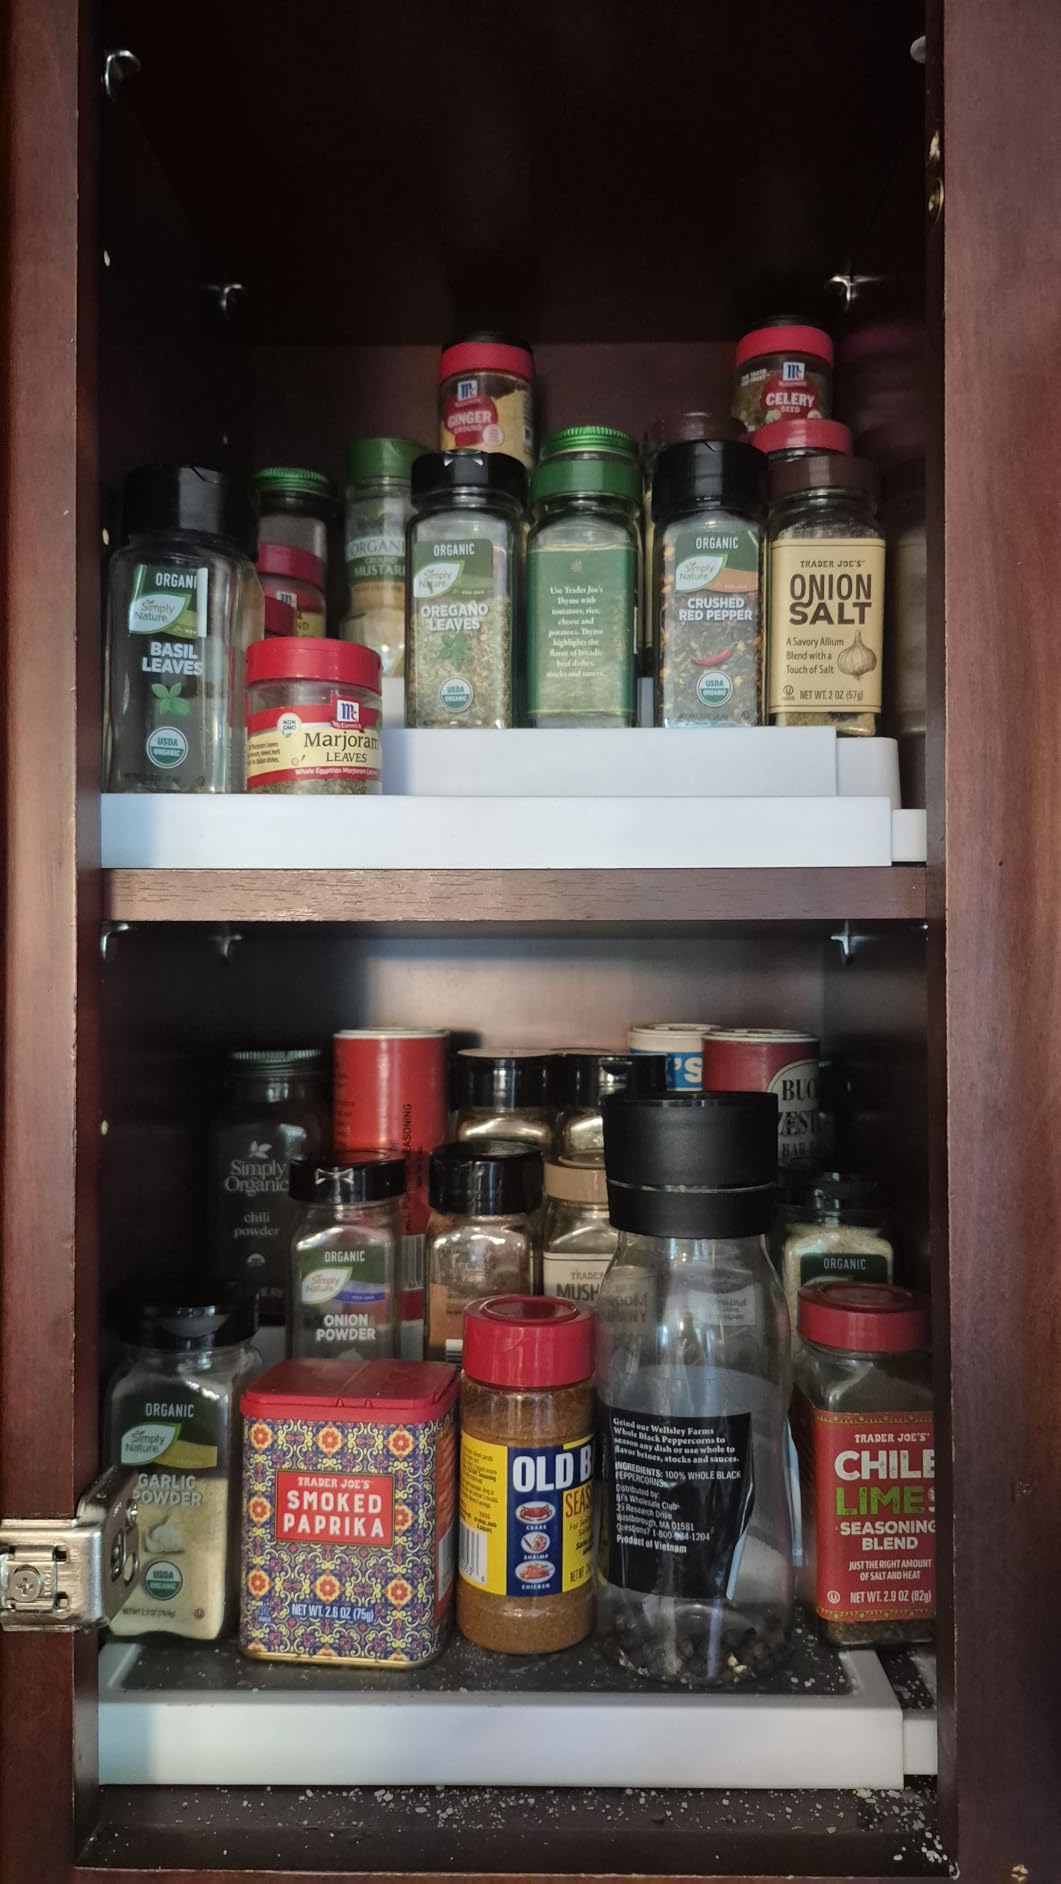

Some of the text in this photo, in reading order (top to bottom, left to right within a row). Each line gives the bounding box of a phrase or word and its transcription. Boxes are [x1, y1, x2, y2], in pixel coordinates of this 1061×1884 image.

[765, 392, 815, 408] CELERY
[447, 410, 492, 428] GINGER
[434, 544, 475, 556] ORGANIC
[696, 536, 738, 550] ORGANIC
[685, 563, 714, 576] Simply
[800, 560, 863, 568] TRADER JOE'S
[680, 571, 708, 581] Nature
[789, 574, 872, 609] ONION
[141, 601, 175, 614] Simply
[421, 603, 489, 618] OREGANO
[688, 598, 745, 609] CRUSHED
[135, 612, 168, 622] Nature
[679, 610, 752, 621] RED PEPPER
[789, 602, 872, 626] SALT
[430, 618, 480, 632] LEAVES
[150, 642, 198, 659] BASIL
[786, 638, 844, 649] A Savory Allium
[786, 652, 808, 660] Blend
[809, 651, 824, 660] with
[142, 656, 204, 676] LEAVES
[786, 665, 834, 674] Touch of Salt
[447, 686, 464, 694] USDA
[706, 680, 724, 688] USDA
[800, 690, 812, 700] NET
[828, 690, 832, 700] 2
[834, 690, 844, 700] OZ
[846, 690, 864, 702] (57g)
[158, 736, 178, 746] USDA
[304, 731, 380, 752] Marjoram
[154, 748, 181, 757] ORGANIC
[326, 752, 368, 763] LEAVES
[296, 768, 314, 776] Whole
[230, 1160, 288, 1180] Simply
[225, 1175, 289, 1197] Organic
[244, 1211, 270, 1223] chili
[233, 1226, 280, 1239] powder
[324, 1250, 366, 1263] ORGANIC
[824, 1258, 866, 1270] ORGANIC
[324, 1314, 369, 1327] ONION
[316, 1328, 376, 1342] POWDER
[146, 1403, 194, 1417] ORGANIC
[613, 1417, 714, 1436] Grind our Wellsley Farms
[131, 1432, 166, 1446] Simply
[614, 1426, 638, 1438] Whole
[638, 1432, 660, 1442] Black
[662, 1436, 715, 1446] Peppercorns
[854, 1432, 926, 1444] TRADER JOE'S
[125, 1443, 160, 1454] Nature
[614, 1437, 638, 1448] season
[640, 1443, 653, 1452] any
[654, 1444, 672, 1454] dish
[700, 1446, 725, 1454] whole
[726, 1446, 736, 1454] to
[615, 1445, 740, 1464] flavor brines, stocks and sauces.
[615, 1461, 742, 1480] INGREDIENTS: 100% WHOLE BLACK
[834, 1449, 936, 1480] CHILE
[512, 1452, 574, 1493] OLD
[138, 1473, 196, 1489] GARLIC
[298, 1477, 370, 1489] TRADER JOE'S
[616, 1484, 649, 1497] Distributed
[132, 1490, 204, 1506] POWDER
[287, 1490, 382, 1515] SMOKED
[629, 1495, 660, 1510] Wholesale
[835, 1485, 924, 1517] LIME
[616, 1504, 673, 1521] 25 Research Drive
[283, 1513, 384, 1538] PAPRIKA
[616, 1523, 650, 1537] Questions?
[659, 1520, 670, 1530] MA
[672, 1521, 694, 1532] 01581
[840, 1520, 936, 1536] SEASONING
[616, 1534, 687, 1554] Product of Vietnam
[862, 1536, 919, 1551] BLEND
[849, 1558, 932, 1571] JUST THE RIGHT AMOUNT
[860, 1570, 921, 1581] OF SALT AND HEAT
[850, 1592, 866, 1604] NET
[884, 1591, 897, 1602] 2.9
[900, 1590, 909, 1602] OZ
[911, 1590, 932, 1604] (82g)
[292, 1604, 307, 1616] NET
[324, 1606, 338, 1618] 2.6
[340, 1607, 352, 1619] OZ
[353, 1608, 374, 1624] (75g)
